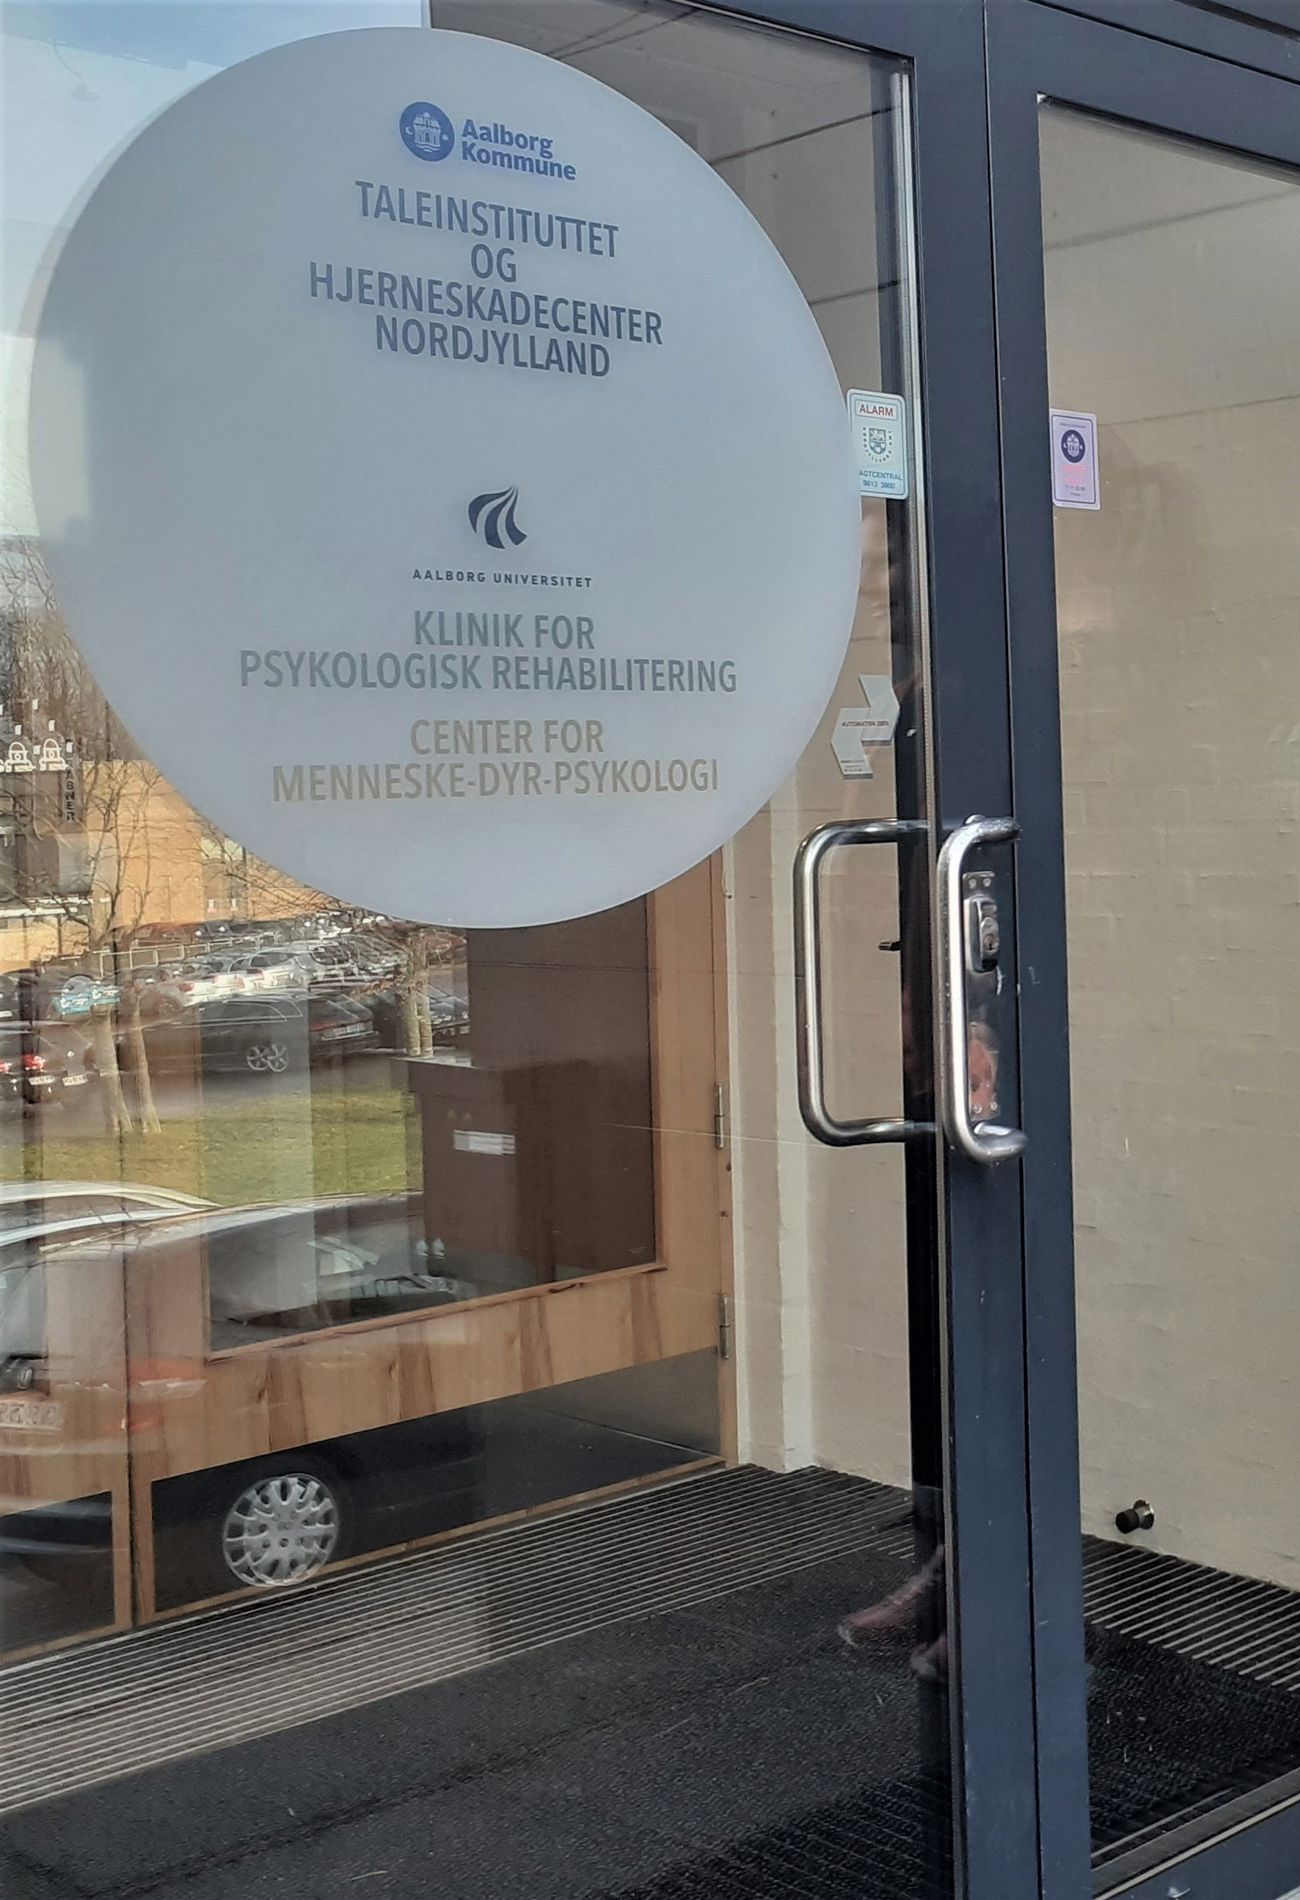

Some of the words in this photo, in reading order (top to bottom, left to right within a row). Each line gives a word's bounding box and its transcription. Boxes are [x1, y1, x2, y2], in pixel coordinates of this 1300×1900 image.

[461, 118, 554, 160] Aalborg
[461, 140, 577, 181] Kommune
[354, 180, 620, 258] TALEINSTITUTTET
[470, 243, 517, 283] OG
[309, 261, 663, 346] HJERNESKADECENTER
[375, 314, 611, 378] NORDJYLLAND
[858, 403, 894, 417] ALARM
[857, 470, 903, 481] AGTCENTRAL
[412, 568, 486, 583] AALBORG
[492, 572, 593, 588] UNIVERSITET
[414, 610, 525, 648] KLINIK
[534, 614, 595, 650] FOR
[240, 649, 483, 690] PSYKOLOGISK
[492, 655, 737, 693] REHABILITERING
[410, 719, 533, 755] CENTER
[544, 719, 604, 754] FOR
[273, 758, 718, 802] MENNESKE-DYR-PSYKOLOGI
